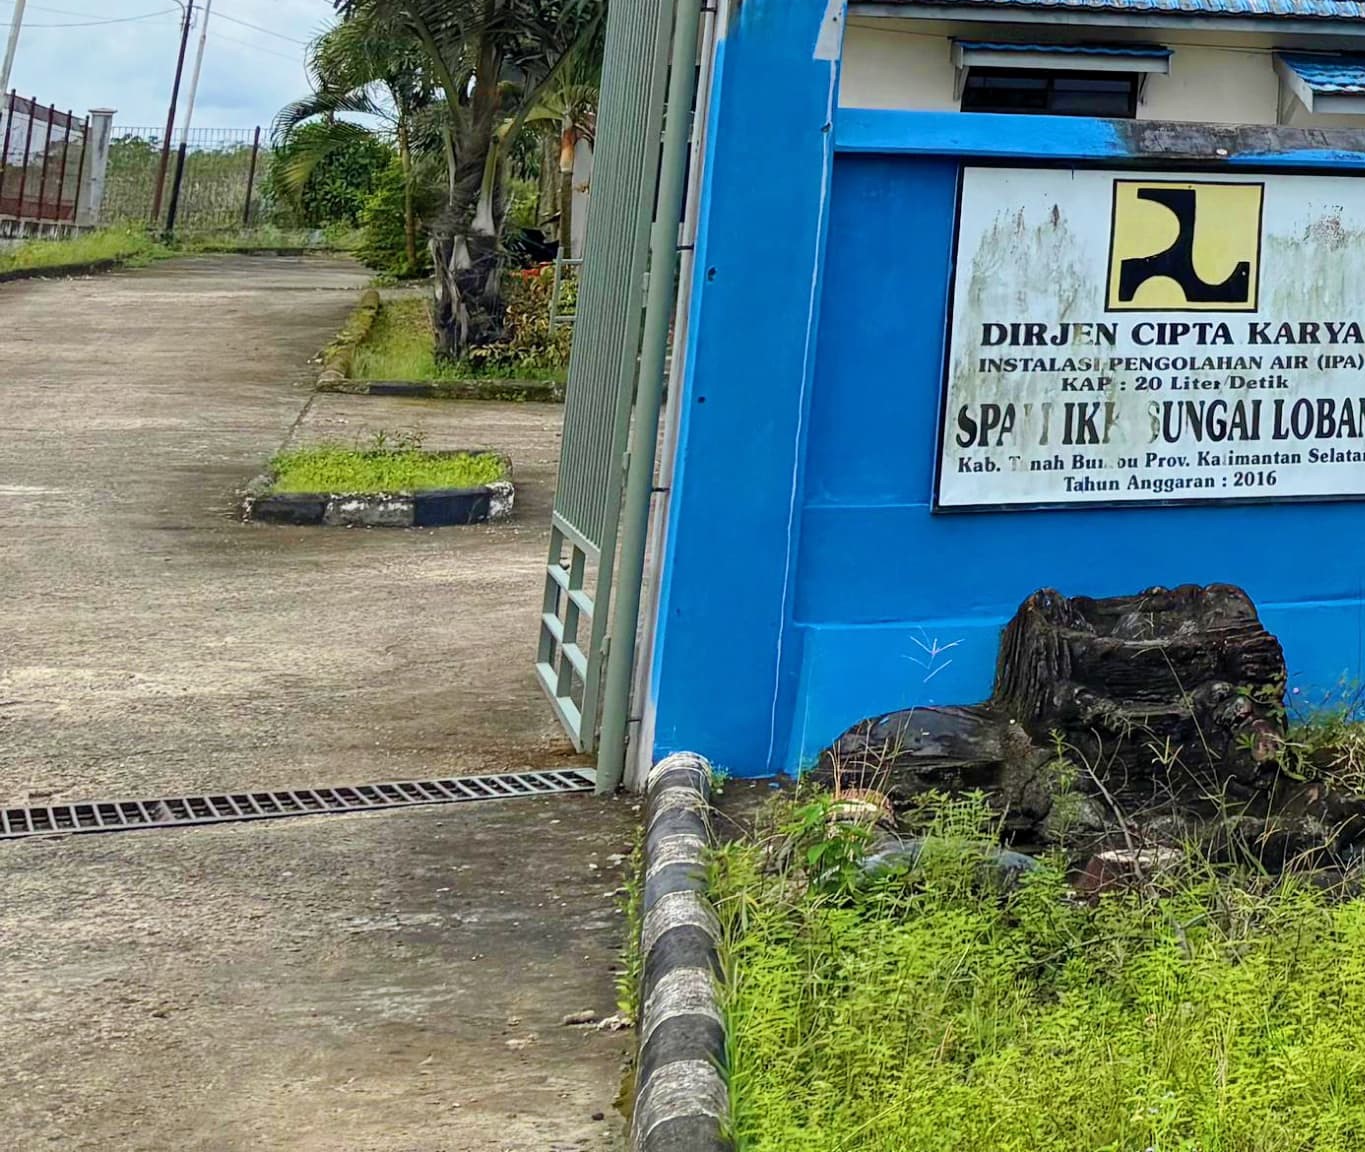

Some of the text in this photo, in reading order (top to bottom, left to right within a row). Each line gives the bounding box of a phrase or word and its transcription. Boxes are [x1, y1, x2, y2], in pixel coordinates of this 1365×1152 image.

[980, 321, 1364, 347] DIRJEN CIPTA KARYA
[978, 353, 1365, 373] INSTALASI PENGOLAHAN AIR (IPA)
[1061, 376, 1112, 392] KAP
[1135, 376, 1162, 390] 20
[958, 457, 1001, 473] Kab.
[1008, 454, 1065, 472] Tnah
[1145, 452, 1190, 468] Prov.
[1064, 476, 1120, 493] Tahun
[1127, 473, 1215, 493] Anggaran
[1233, 470, 1277, 487] 2016
